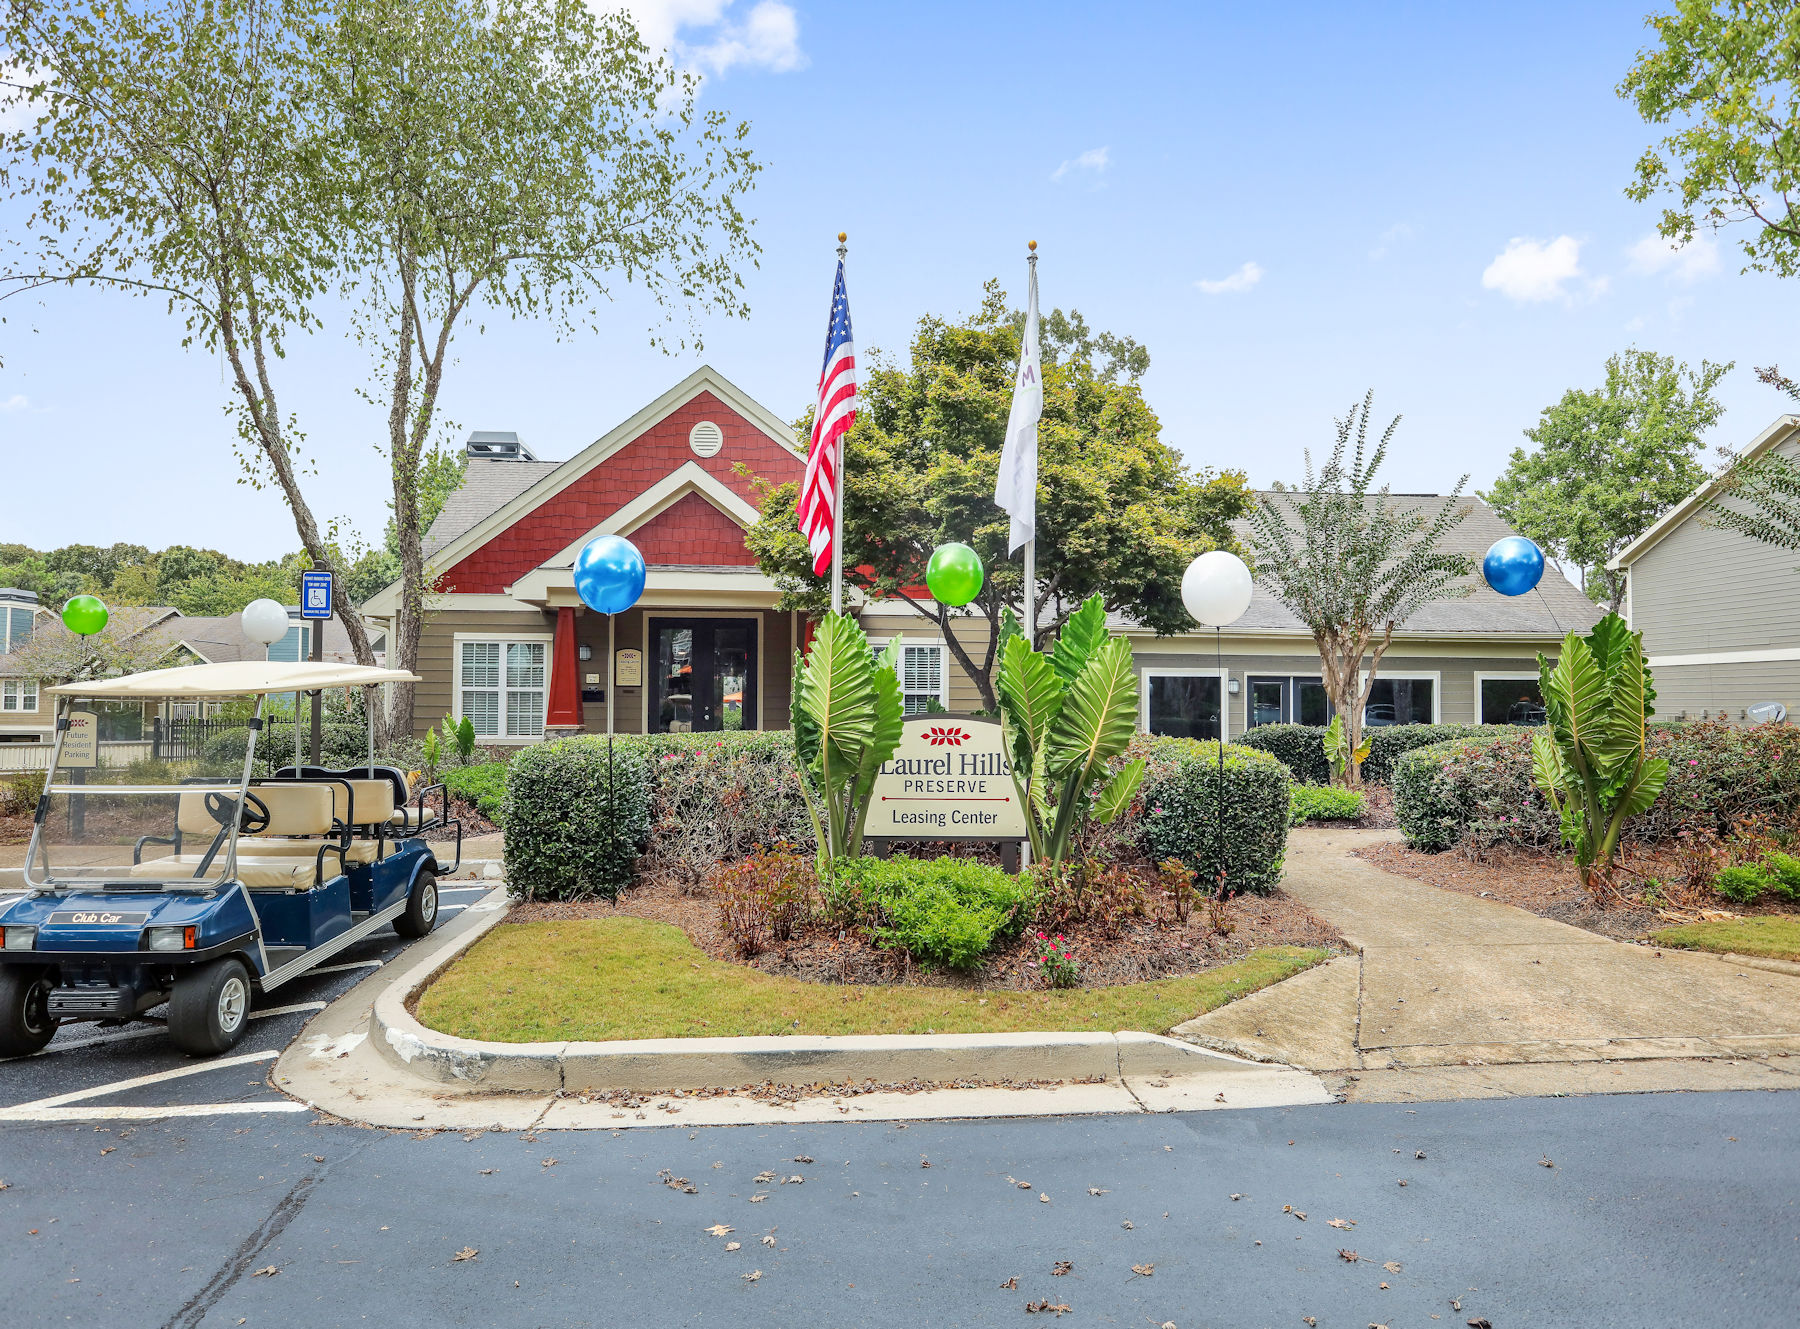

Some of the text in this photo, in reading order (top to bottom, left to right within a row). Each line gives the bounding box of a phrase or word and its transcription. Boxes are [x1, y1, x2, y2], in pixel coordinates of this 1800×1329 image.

[66, 731, 89, 739] Future
[63, 741, 92, 749] Resident
[64, 750, 90, 760] Parking
[879, 752, 1012, 776] Laurel Hills
[904, 780, 987, 793] PRESERVE
[892, 809, 998, 827] Leasing Center
[71, 913, 122, 923] Club Car
